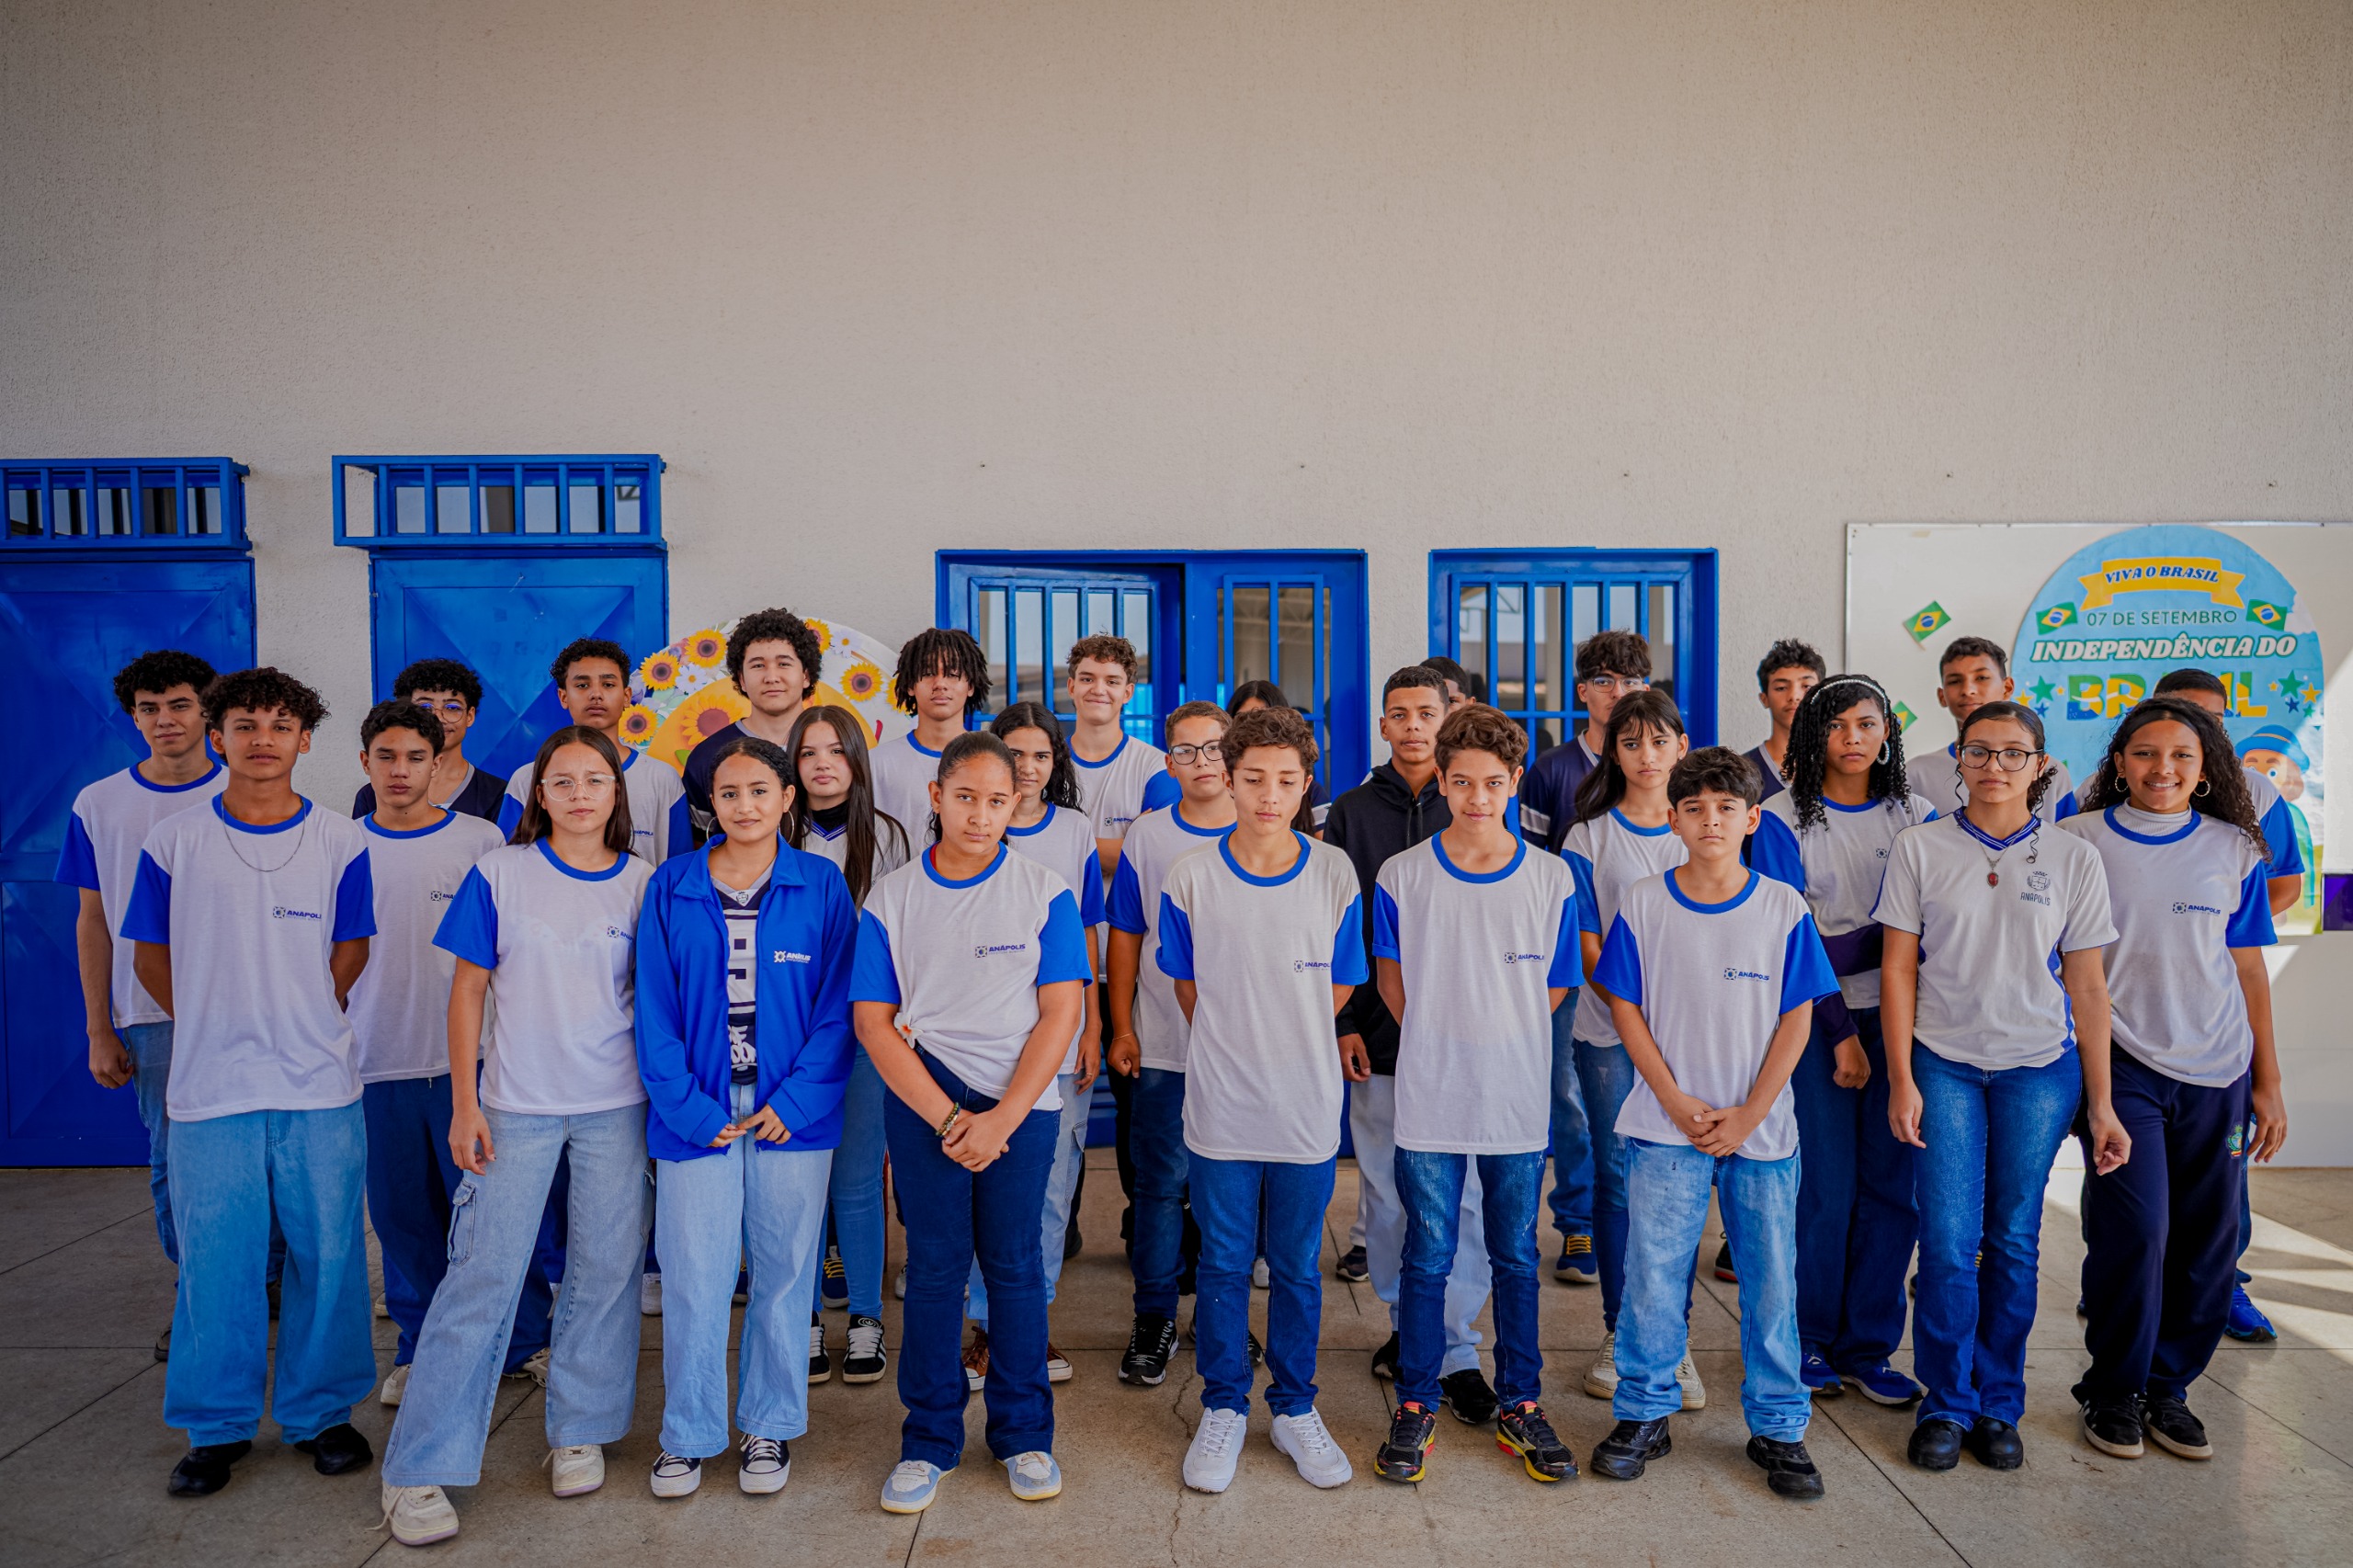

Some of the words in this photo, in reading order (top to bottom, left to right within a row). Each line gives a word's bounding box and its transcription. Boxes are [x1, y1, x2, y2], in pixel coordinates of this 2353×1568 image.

[2105, 566, 2143, 584] VIVA
[2145, 565, 2157, 577] O
[2159, 565, 2220, 583] BRASIL
[2086, 612, 2108, 627] 07
[2113, 612, 2136, 626] DE
[2142, 610, 2238, 626] SETEMBRO
[2030, 631, 2254, 662] INDEPENDÊNCIA
[2255, 635, 2298, 657] DO
[2066, 671, 2268, 721] BRIL
